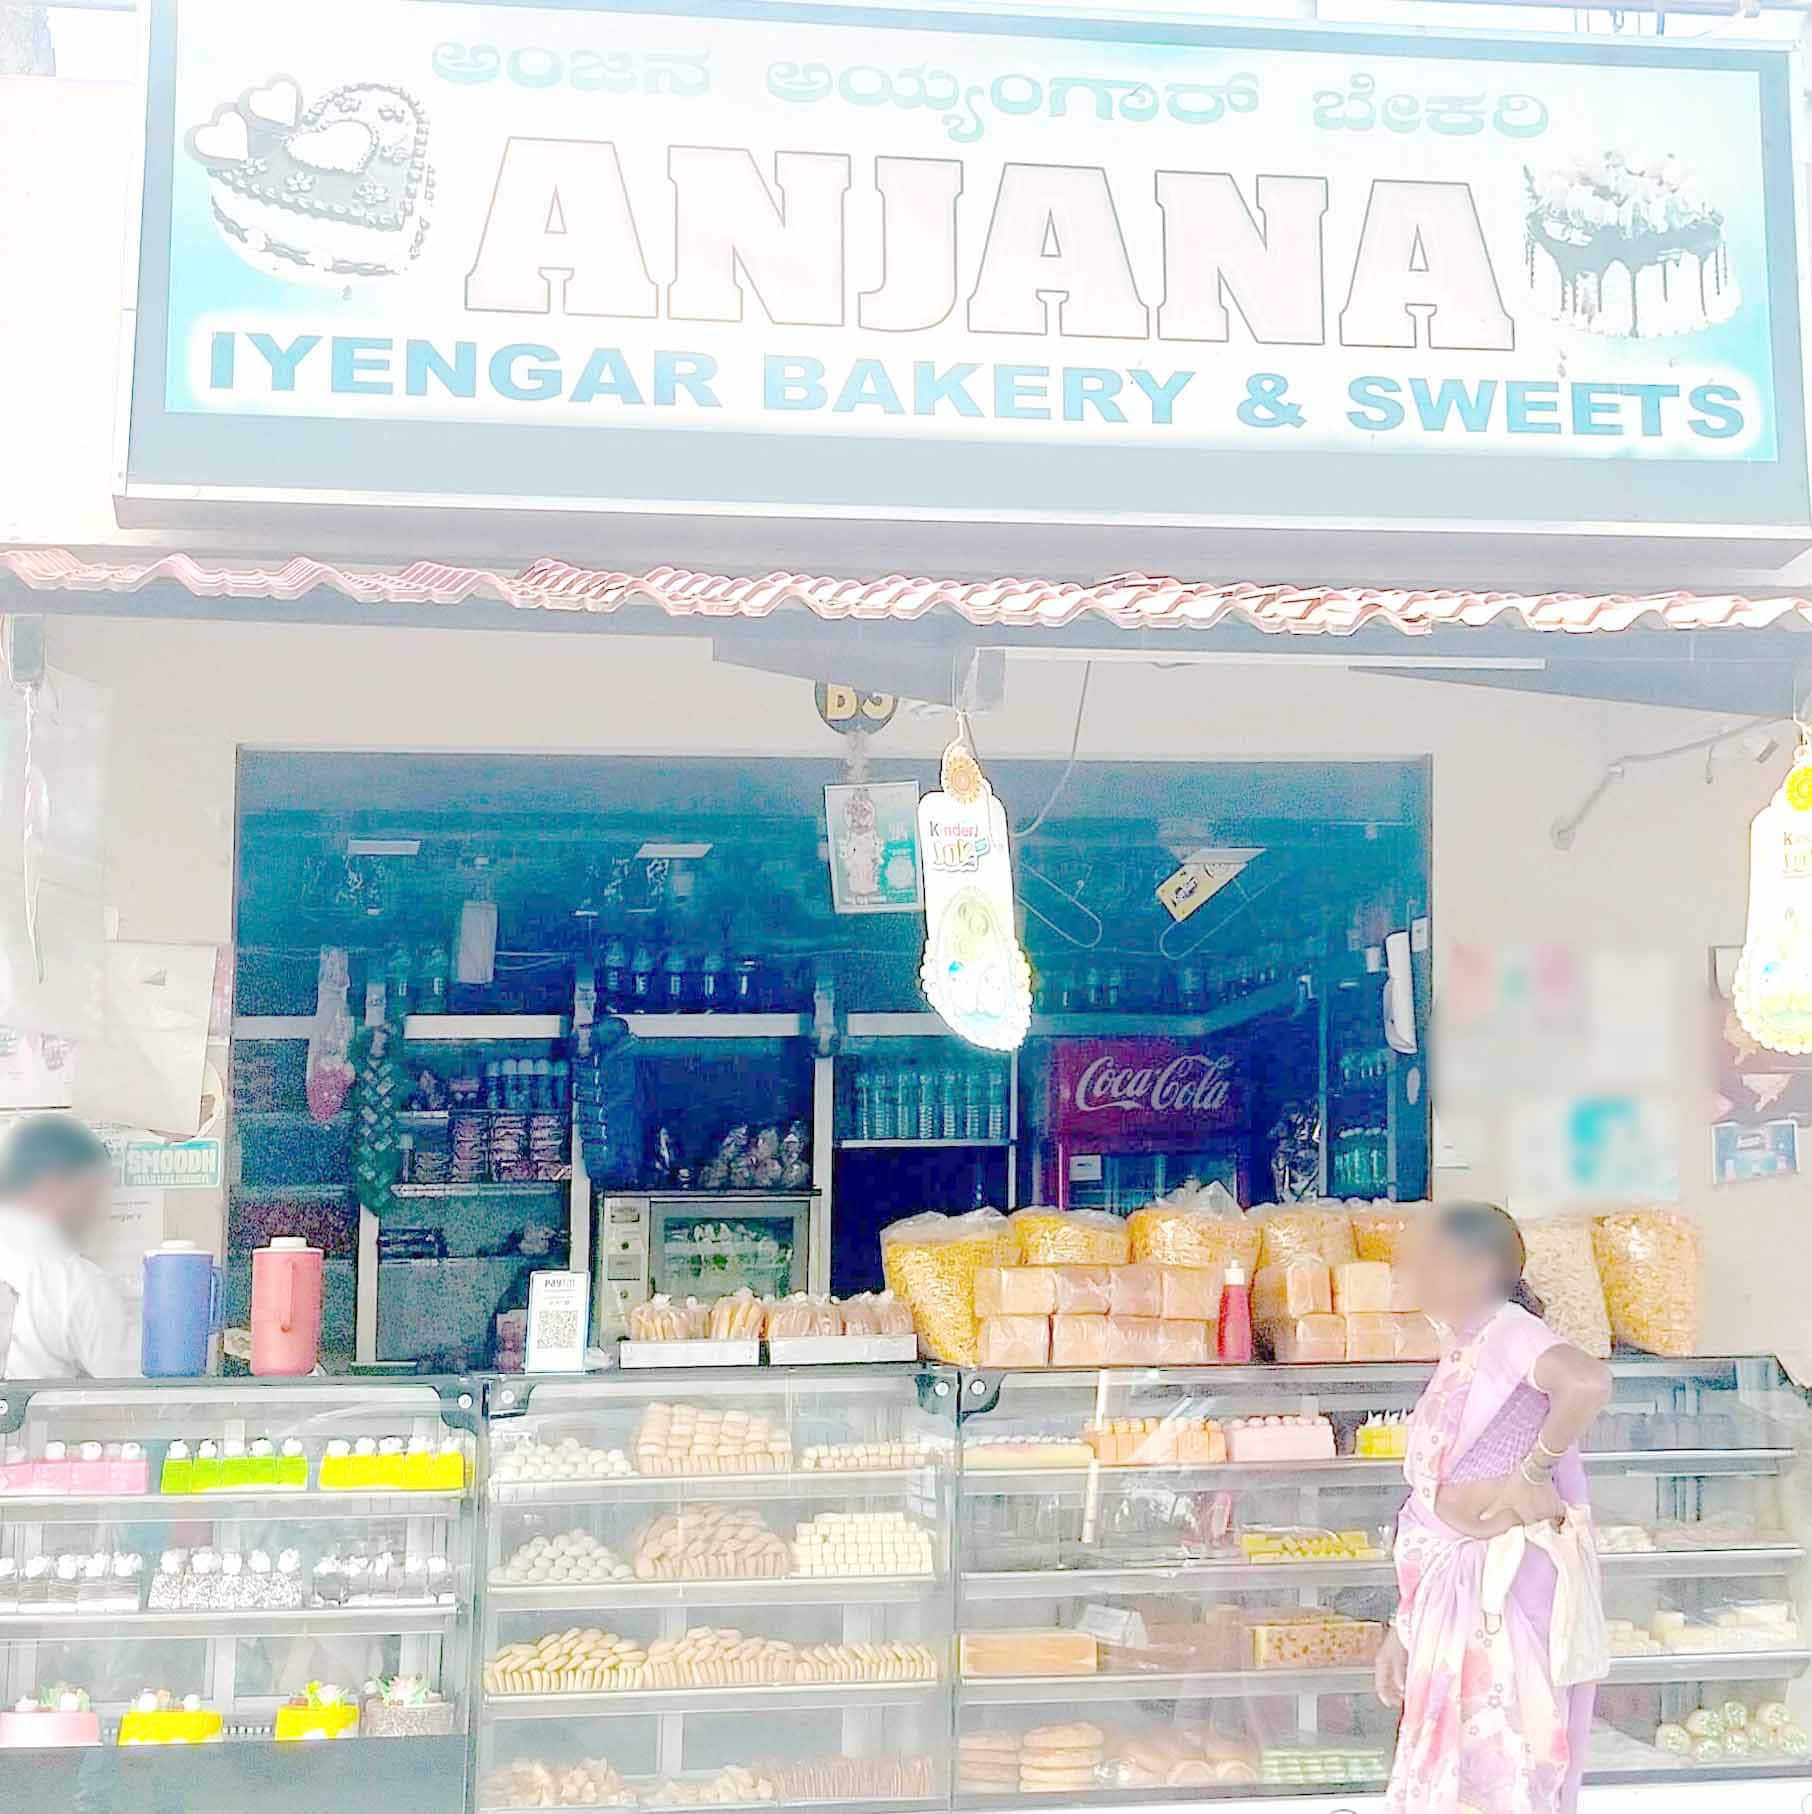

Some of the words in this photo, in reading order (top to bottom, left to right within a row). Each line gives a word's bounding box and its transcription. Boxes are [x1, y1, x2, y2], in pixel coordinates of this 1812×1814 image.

[1312, 72, 1550, 140] ಬೇಕರಿ
[465, 136, 1515, 352] ANJANA
[209, 330, 723, 409] IYENGAR
[763, 354, 1196, 426] BAKERY
[1236, 372, 1308, 430] &
[1345, 375, 1746, 439] SWEETS
